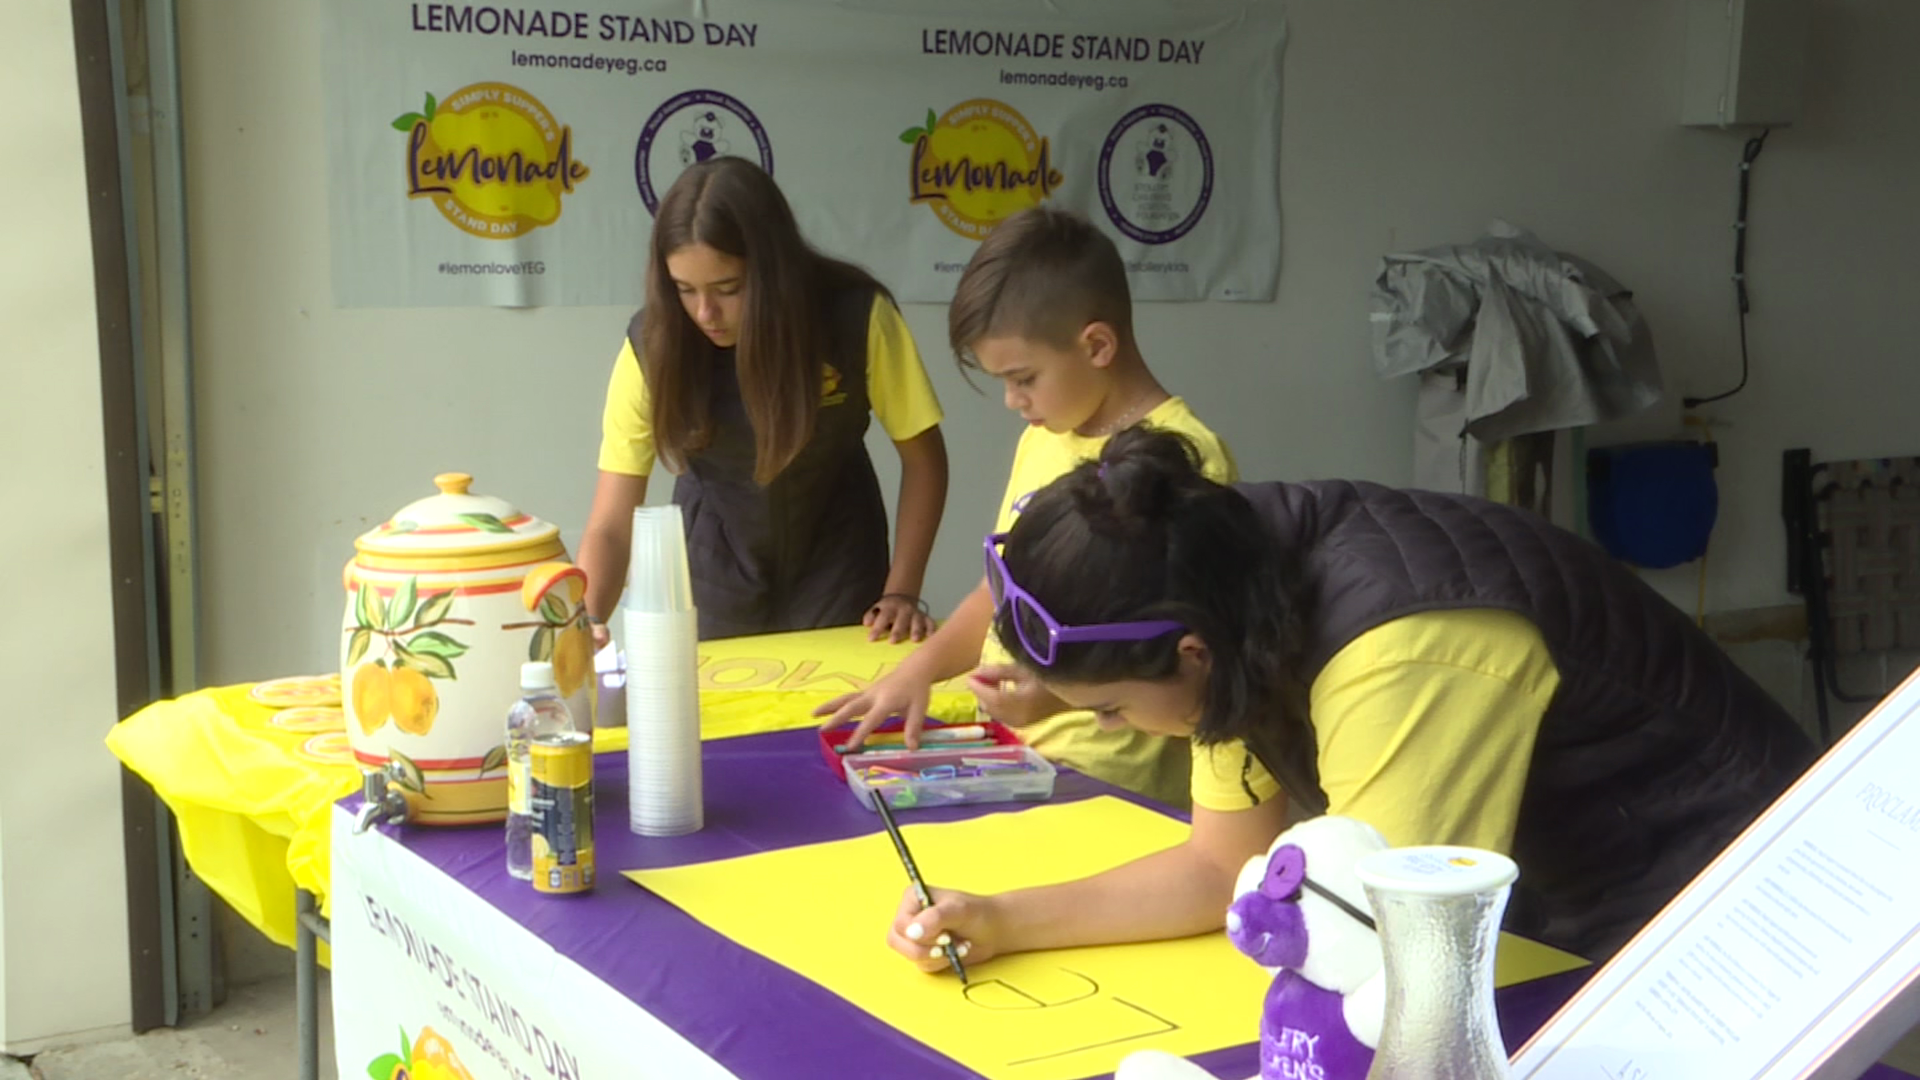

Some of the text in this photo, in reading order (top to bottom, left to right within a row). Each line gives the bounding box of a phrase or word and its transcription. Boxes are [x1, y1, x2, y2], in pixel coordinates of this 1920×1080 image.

[412, 3, 758, 47] LEMONADE STAND DAY
[922, 29, 1205, 65] LEMONADE STAND DAY
[511, 50, 667, 76] lemonadeyeg.ca
[1000, 69, 1129, 91] lemonadeyeg.ca
[452, 89, 500, 112] SIMPLY
[950, 105, 990, 125] SIMPLY
[409, 121, 587, 194] Lemonade
[911, 135, 1062, 201] Lemonade
[444, 199, 519, 234] STAND DAY
[940, 204, 977, 233] STAND
[438, 260, 546, 276] #lemonloveYEG
